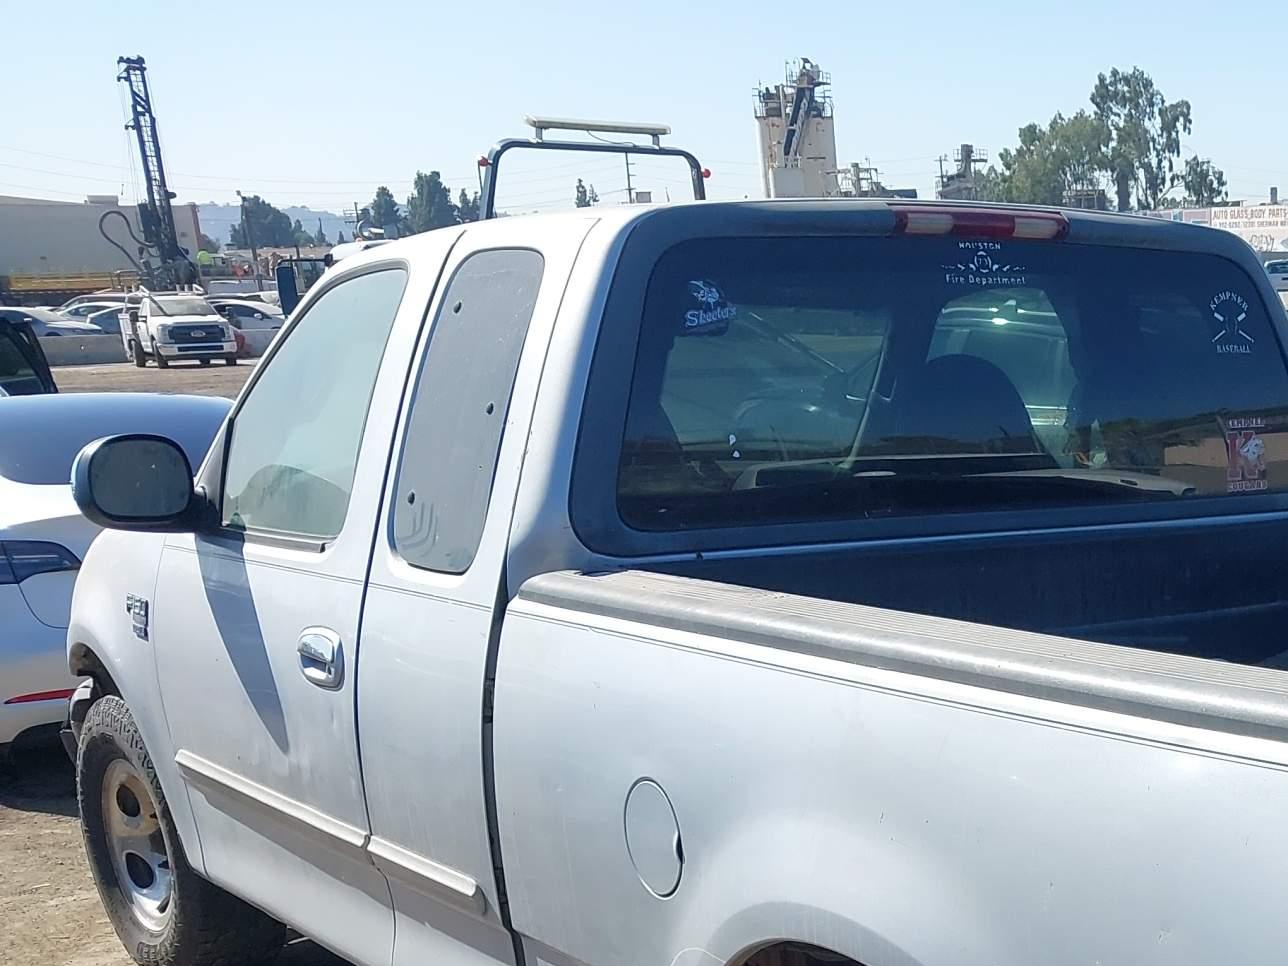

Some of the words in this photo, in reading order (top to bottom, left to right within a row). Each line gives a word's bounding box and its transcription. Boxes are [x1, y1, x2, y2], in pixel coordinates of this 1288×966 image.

[1213, 209, 1228, 220] AUTO
[945, 273, 965, 284] Fire
[968, 274, 1026, 286] Department
